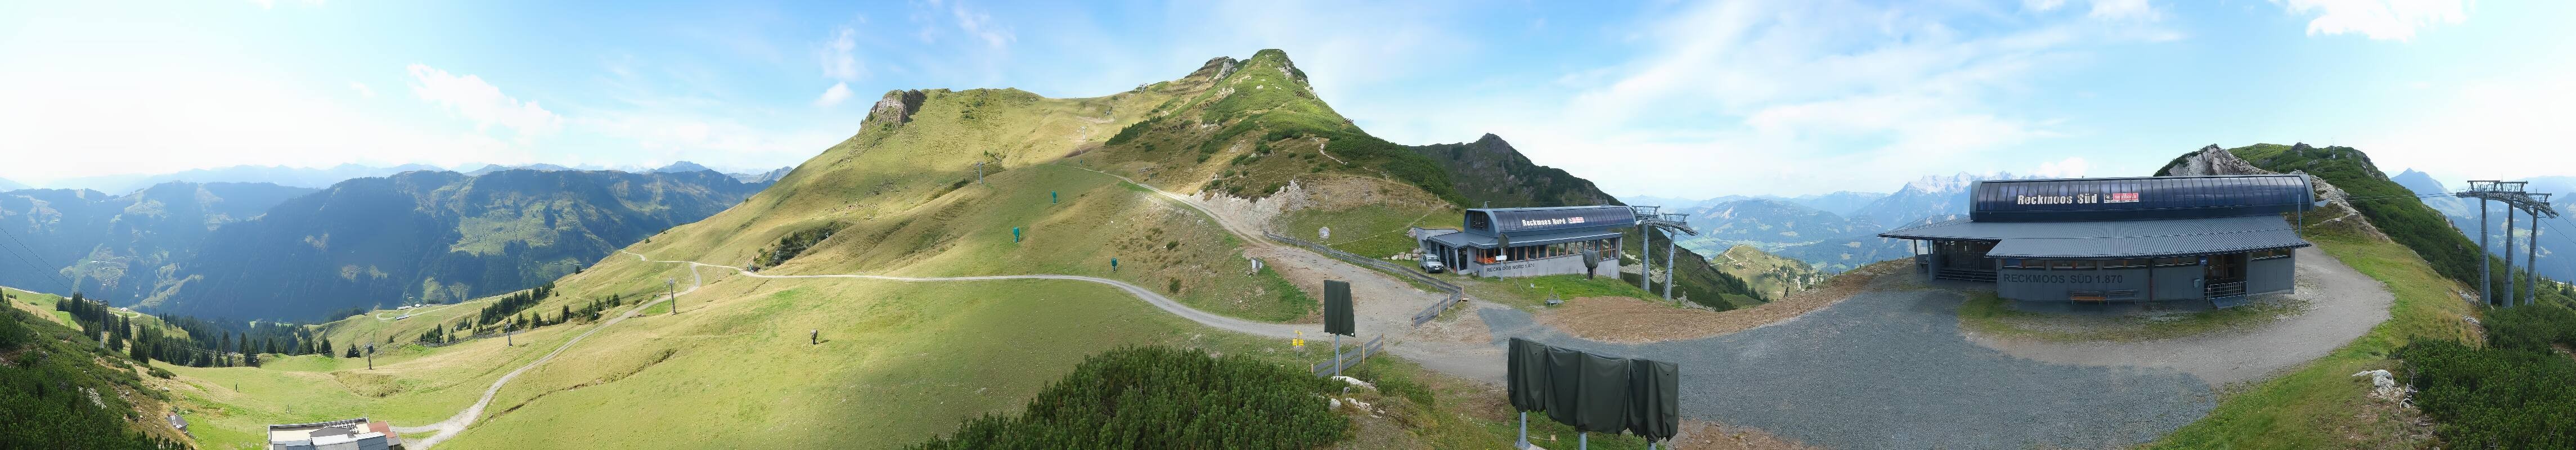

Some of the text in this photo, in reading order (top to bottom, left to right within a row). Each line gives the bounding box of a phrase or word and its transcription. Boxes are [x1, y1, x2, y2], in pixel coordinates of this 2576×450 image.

[2017, 194, 2097, 205] Reckmoos Süd
[2003, 273, 2123, 284] RECKMOOS SÜD 1.870
